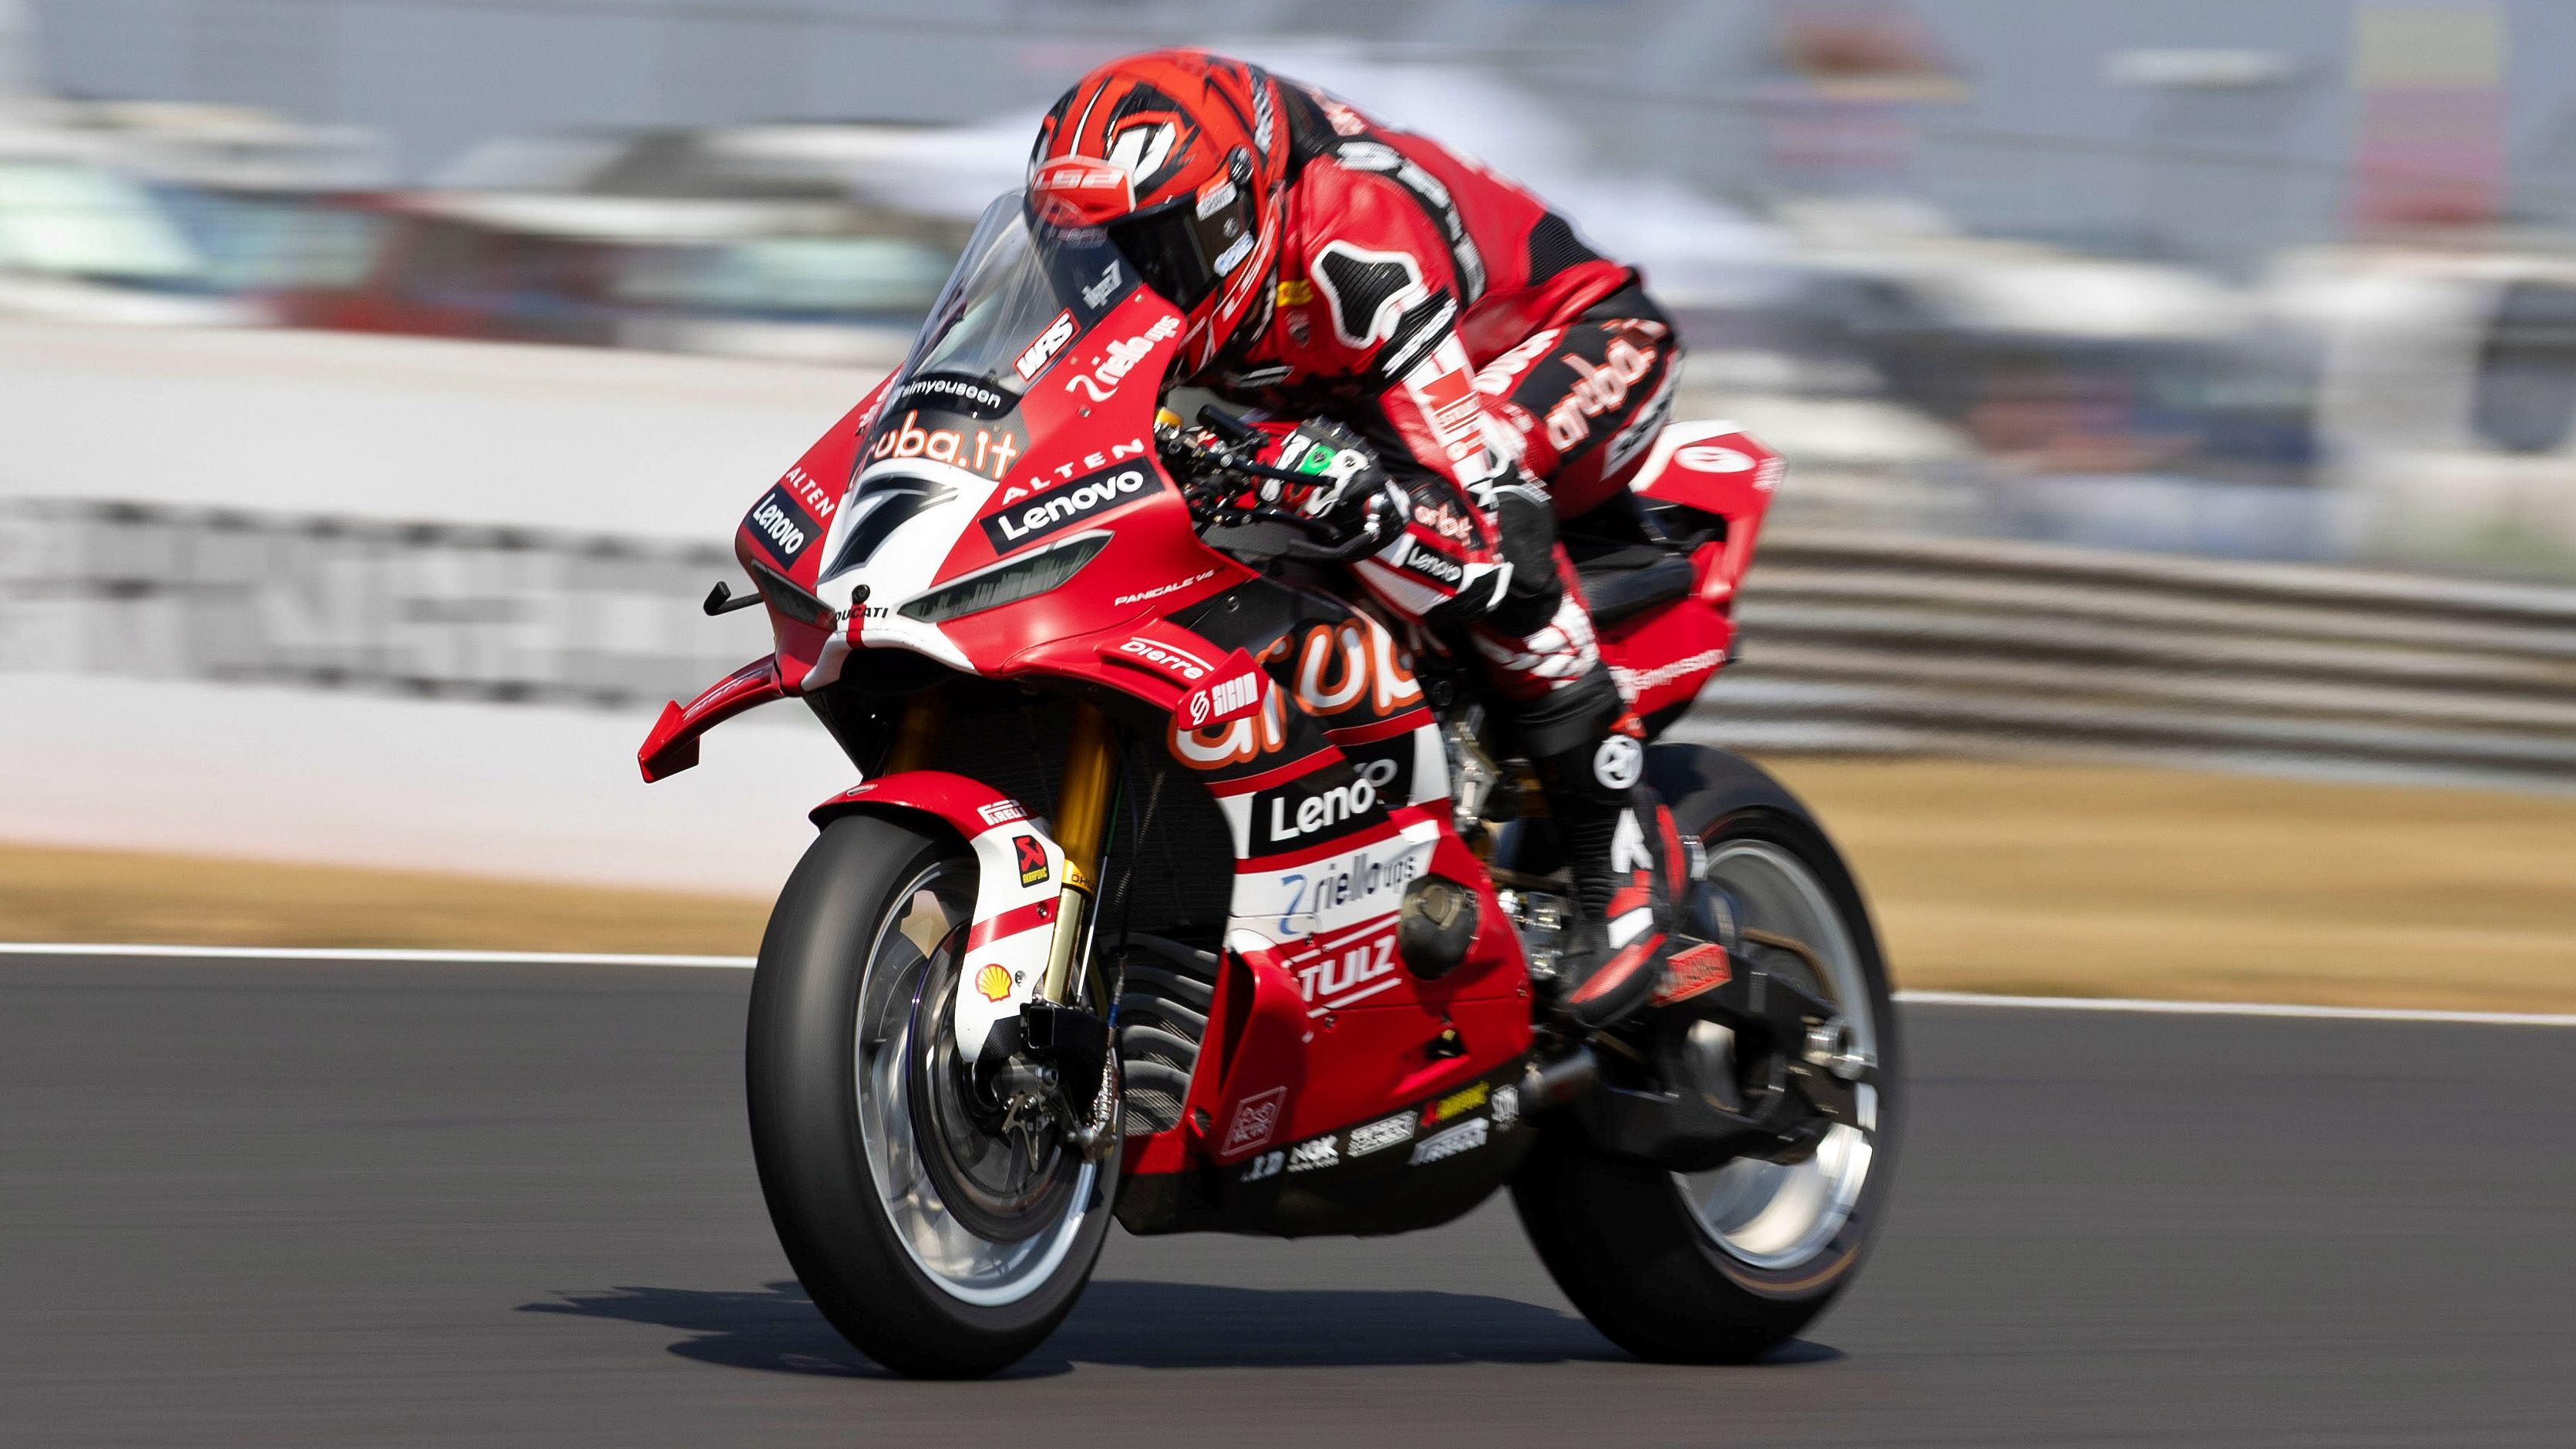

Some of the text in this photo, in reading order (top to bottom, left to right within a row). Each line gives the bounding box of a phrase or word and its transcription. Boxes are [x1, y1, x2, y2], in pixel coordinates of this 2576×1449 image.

[785, 466, 836, 519] ALTEN
[997, 470, 1145, 541] Lenovo
[1001, 438, 1145, 506] ALTEN
[752, 493, 805, 555] Lenovo
[813, 472, 959, 587] 7
[1297, 935, 1396, 1003] TULZ
